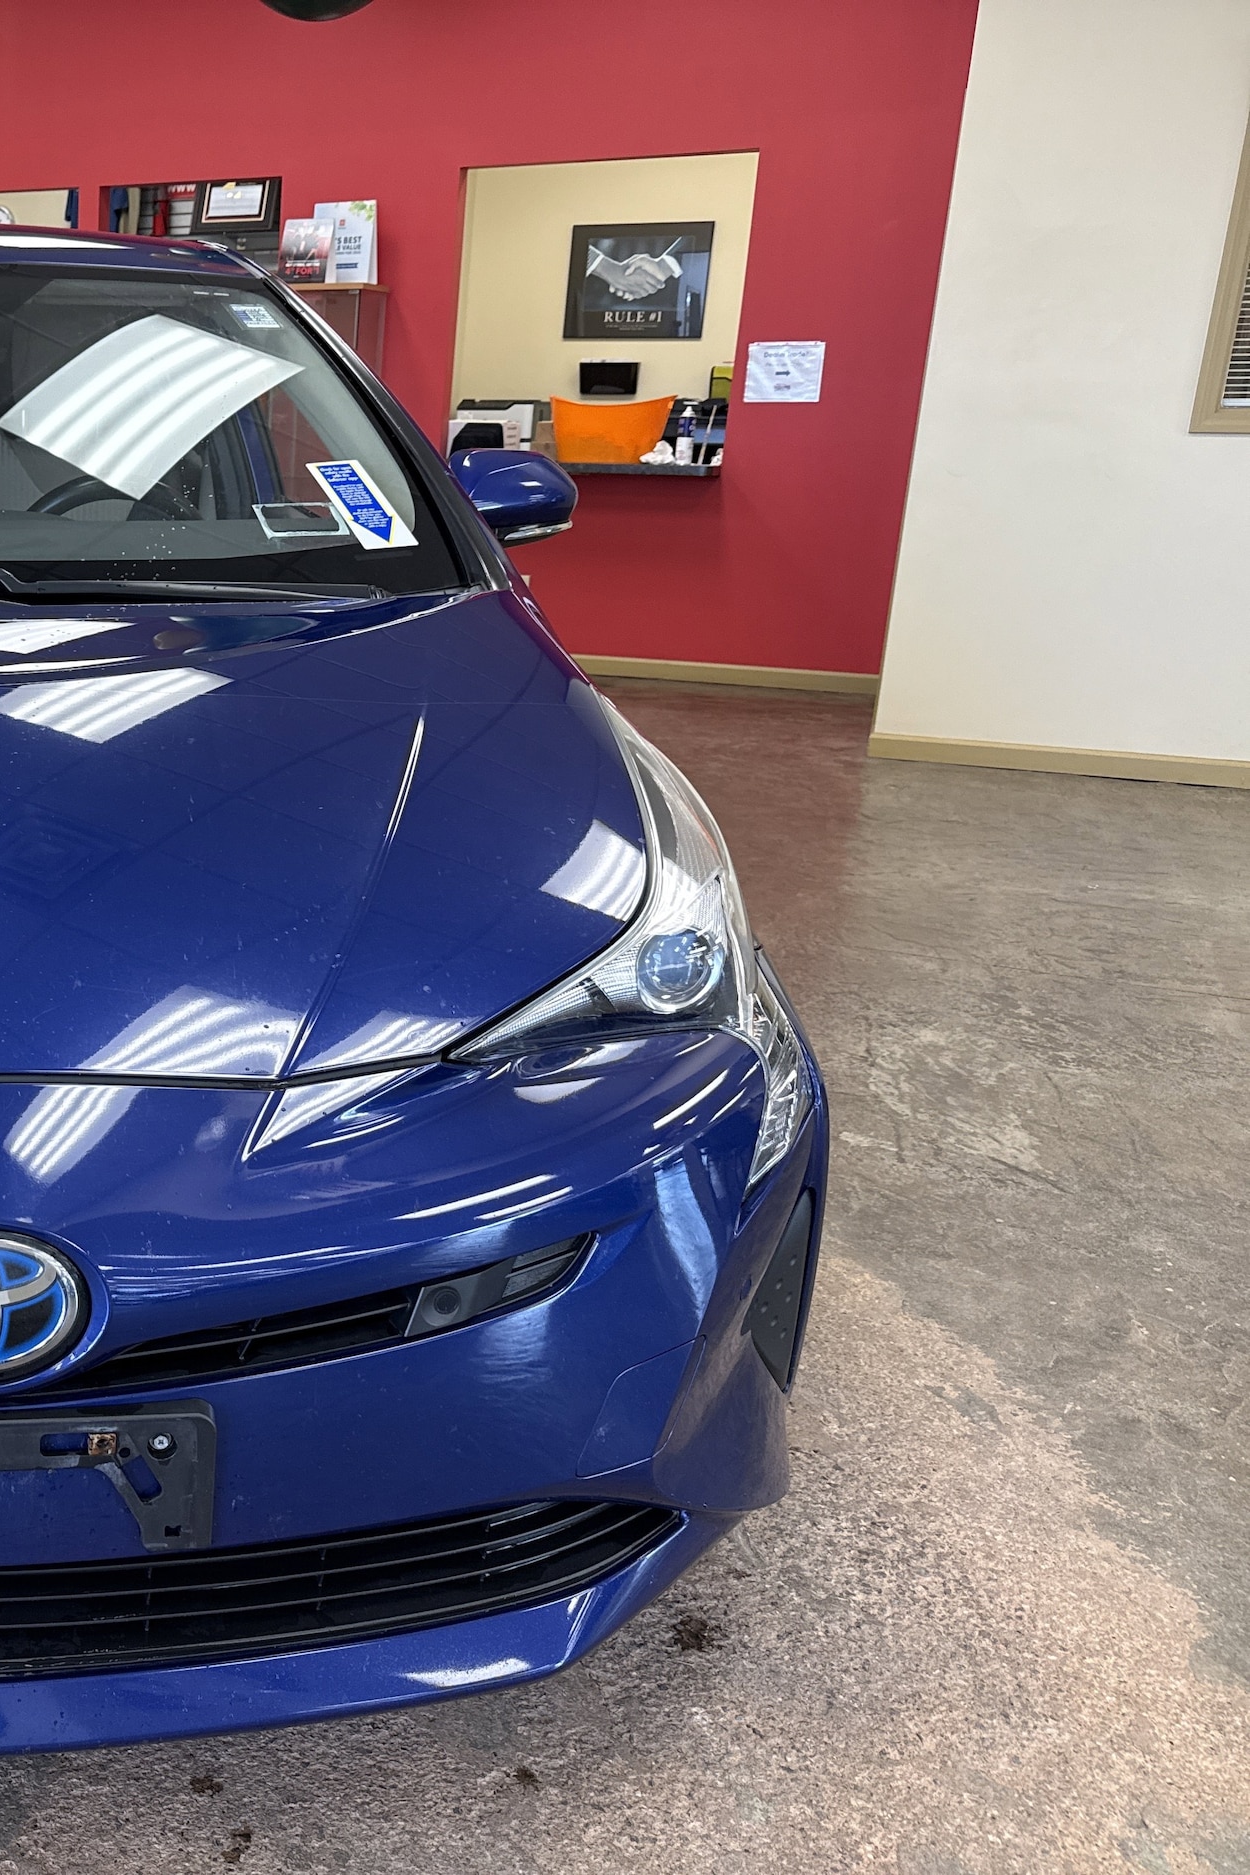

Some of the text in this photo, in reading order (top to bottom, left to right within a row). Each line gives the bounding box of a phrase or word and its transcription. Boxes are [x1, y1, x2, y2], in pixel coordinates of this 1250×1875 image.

[343, 236, 362, 244] BEST
[295, 267, 311, 275] FOR
[604, 311, 663, 323] RULE #1
